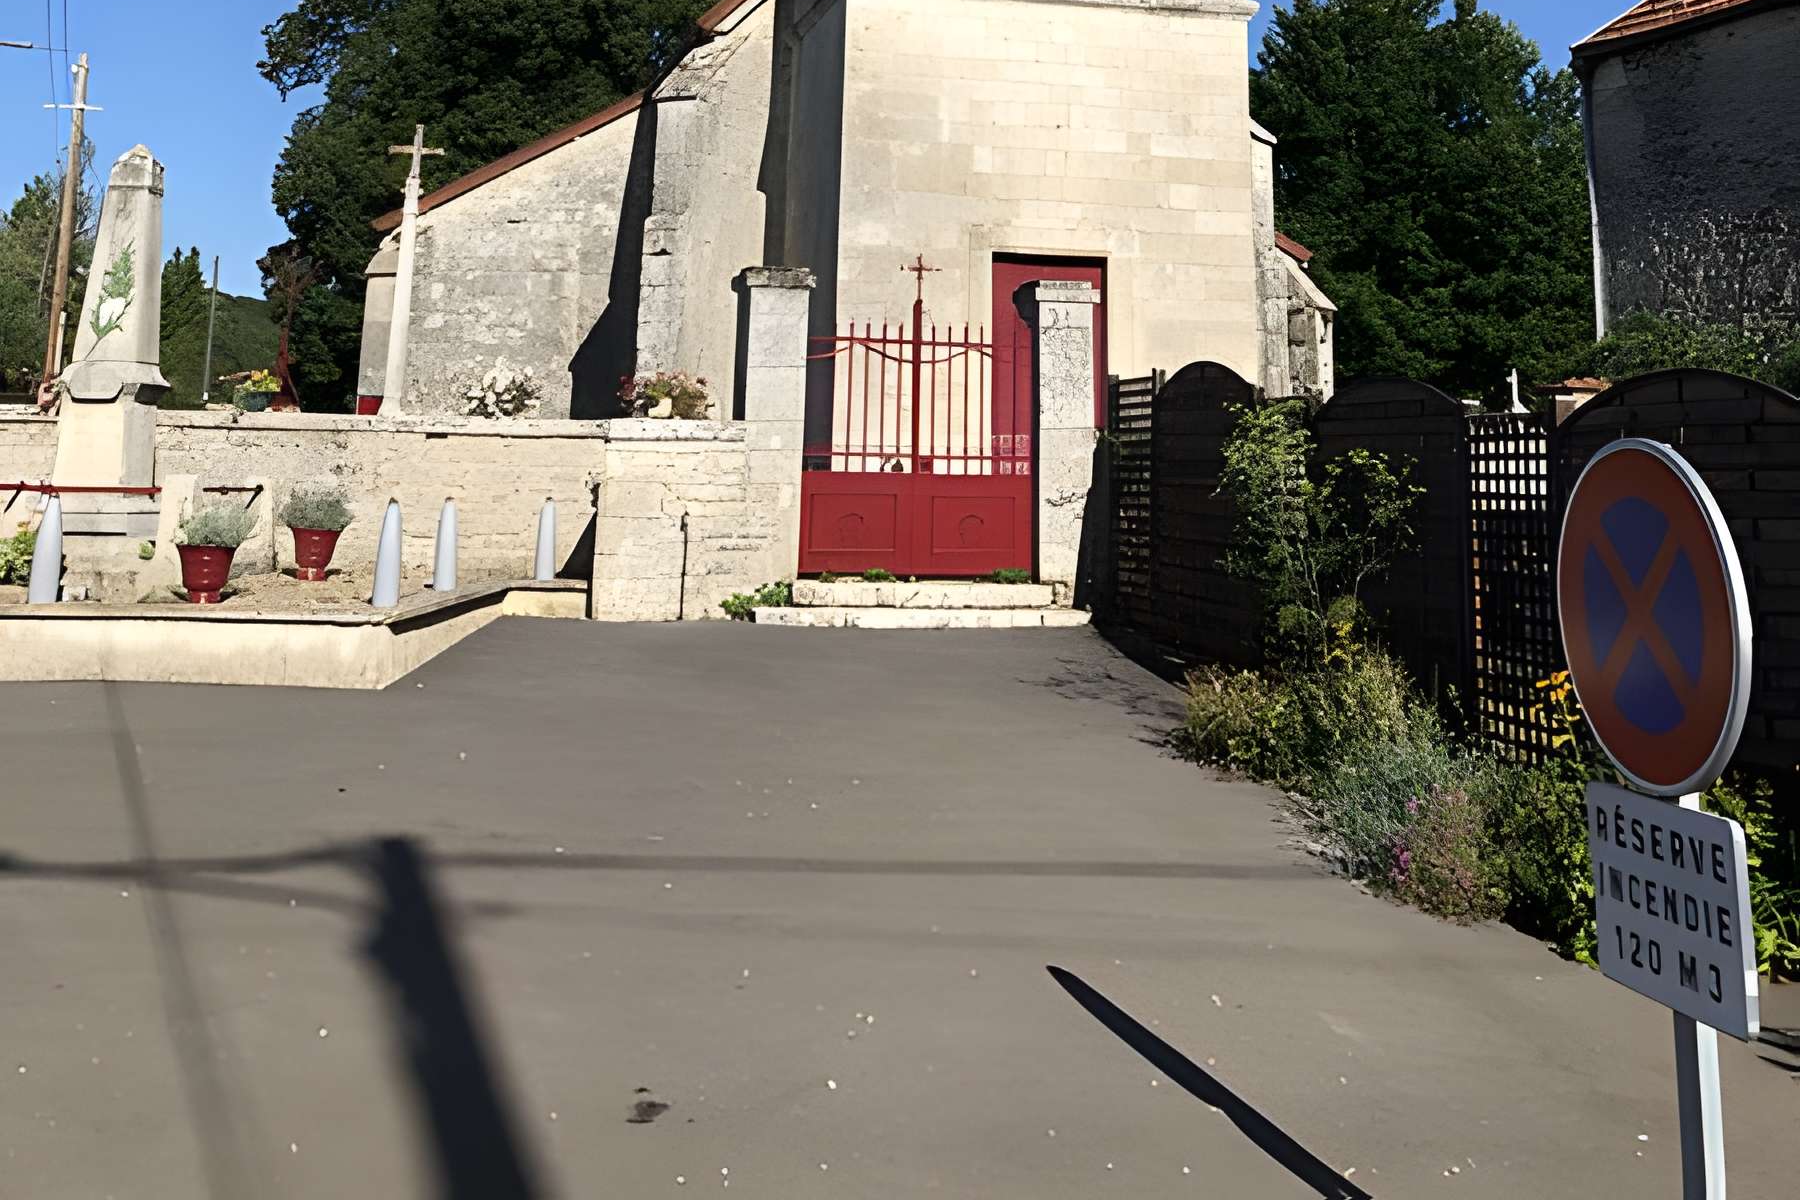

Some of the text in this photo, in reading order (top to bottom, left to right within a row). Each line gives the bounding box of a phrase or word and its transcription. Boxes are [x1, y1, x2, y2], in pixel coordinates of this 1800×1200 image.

[1597, 805, 1727, 884] RÉSERVE
[1600, 862, 1732, 947] INCENDIE
[1616, 925, 1661, 975] 120
